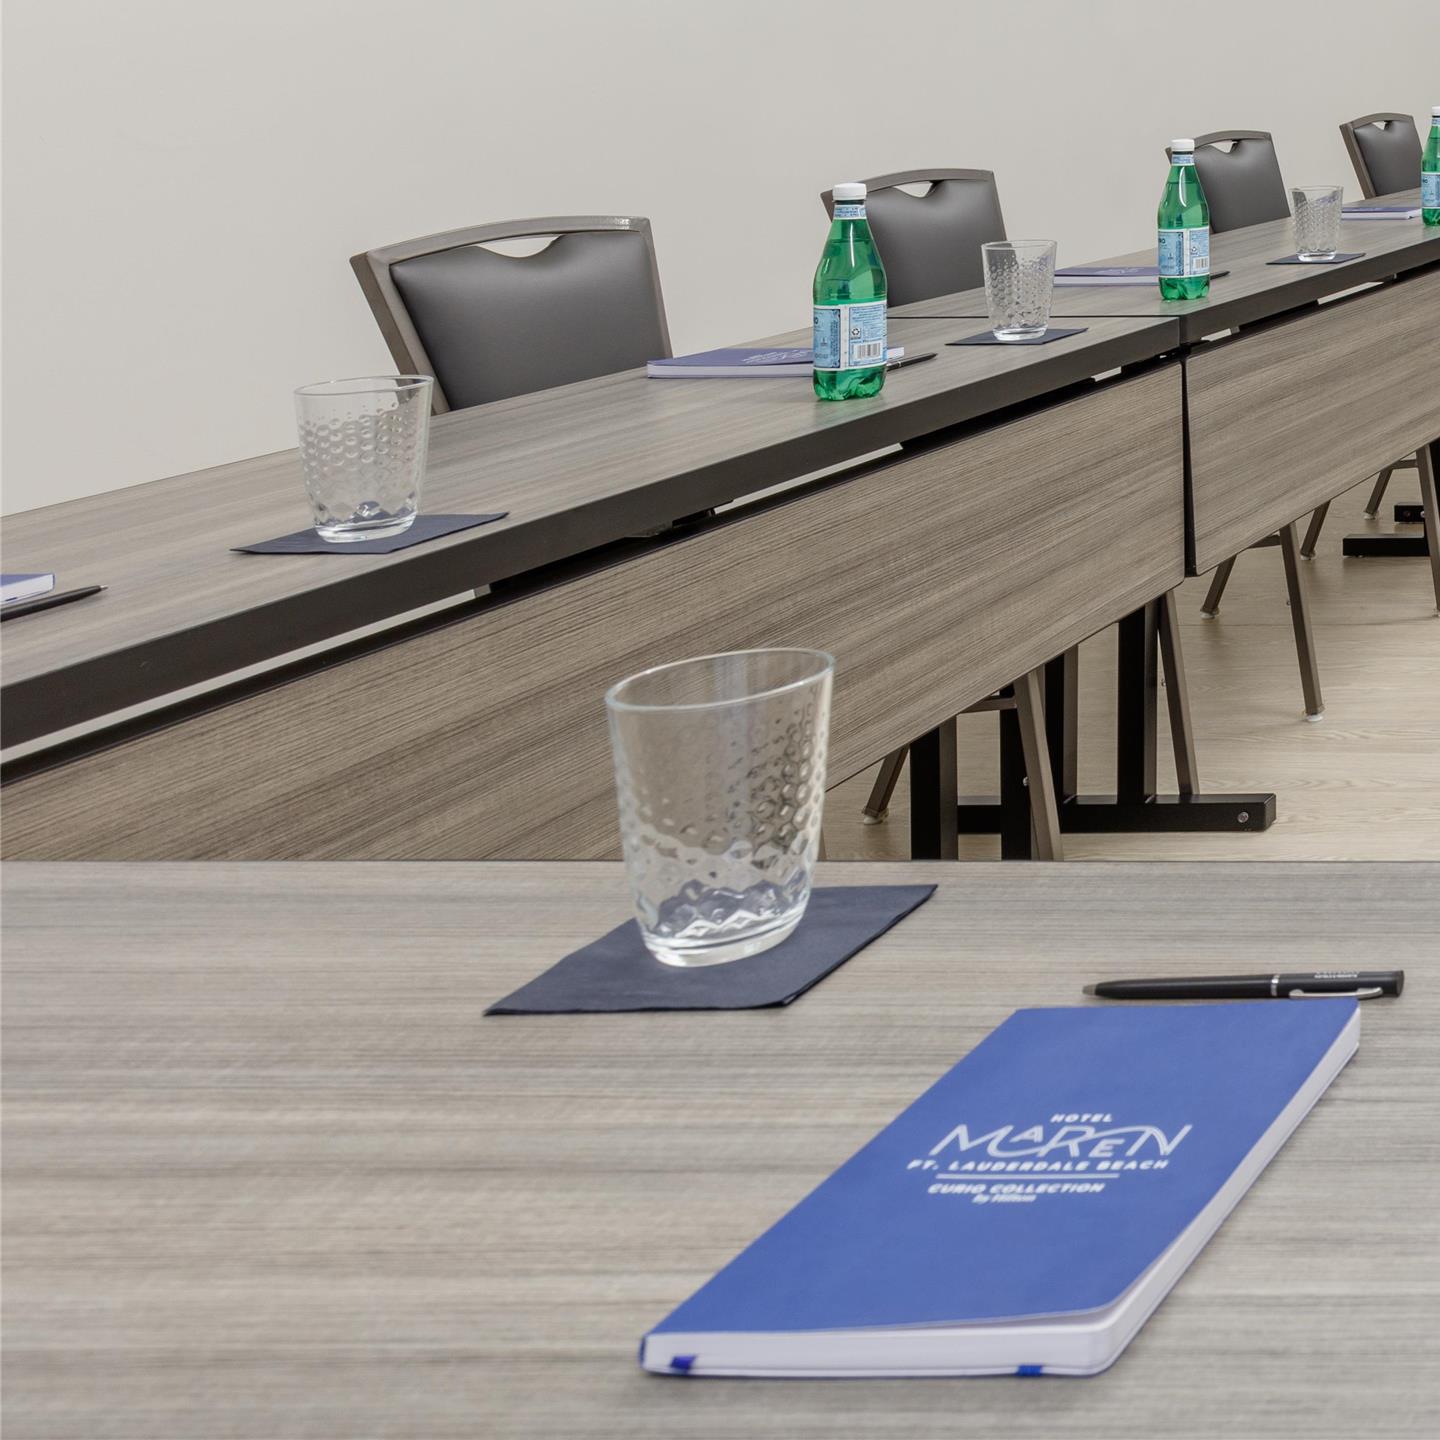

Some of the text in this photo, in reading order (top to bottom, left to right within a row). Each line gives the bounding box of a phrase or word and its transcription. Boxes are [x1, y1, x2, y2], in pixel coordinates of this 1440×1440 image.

[1050, 1113, 1113, 1122] HOTEL
[906, 1159, 1169, 1171] FT. LAUDERDALE BEACH
[989, 1182, 1106, 1194] COLLECTION
